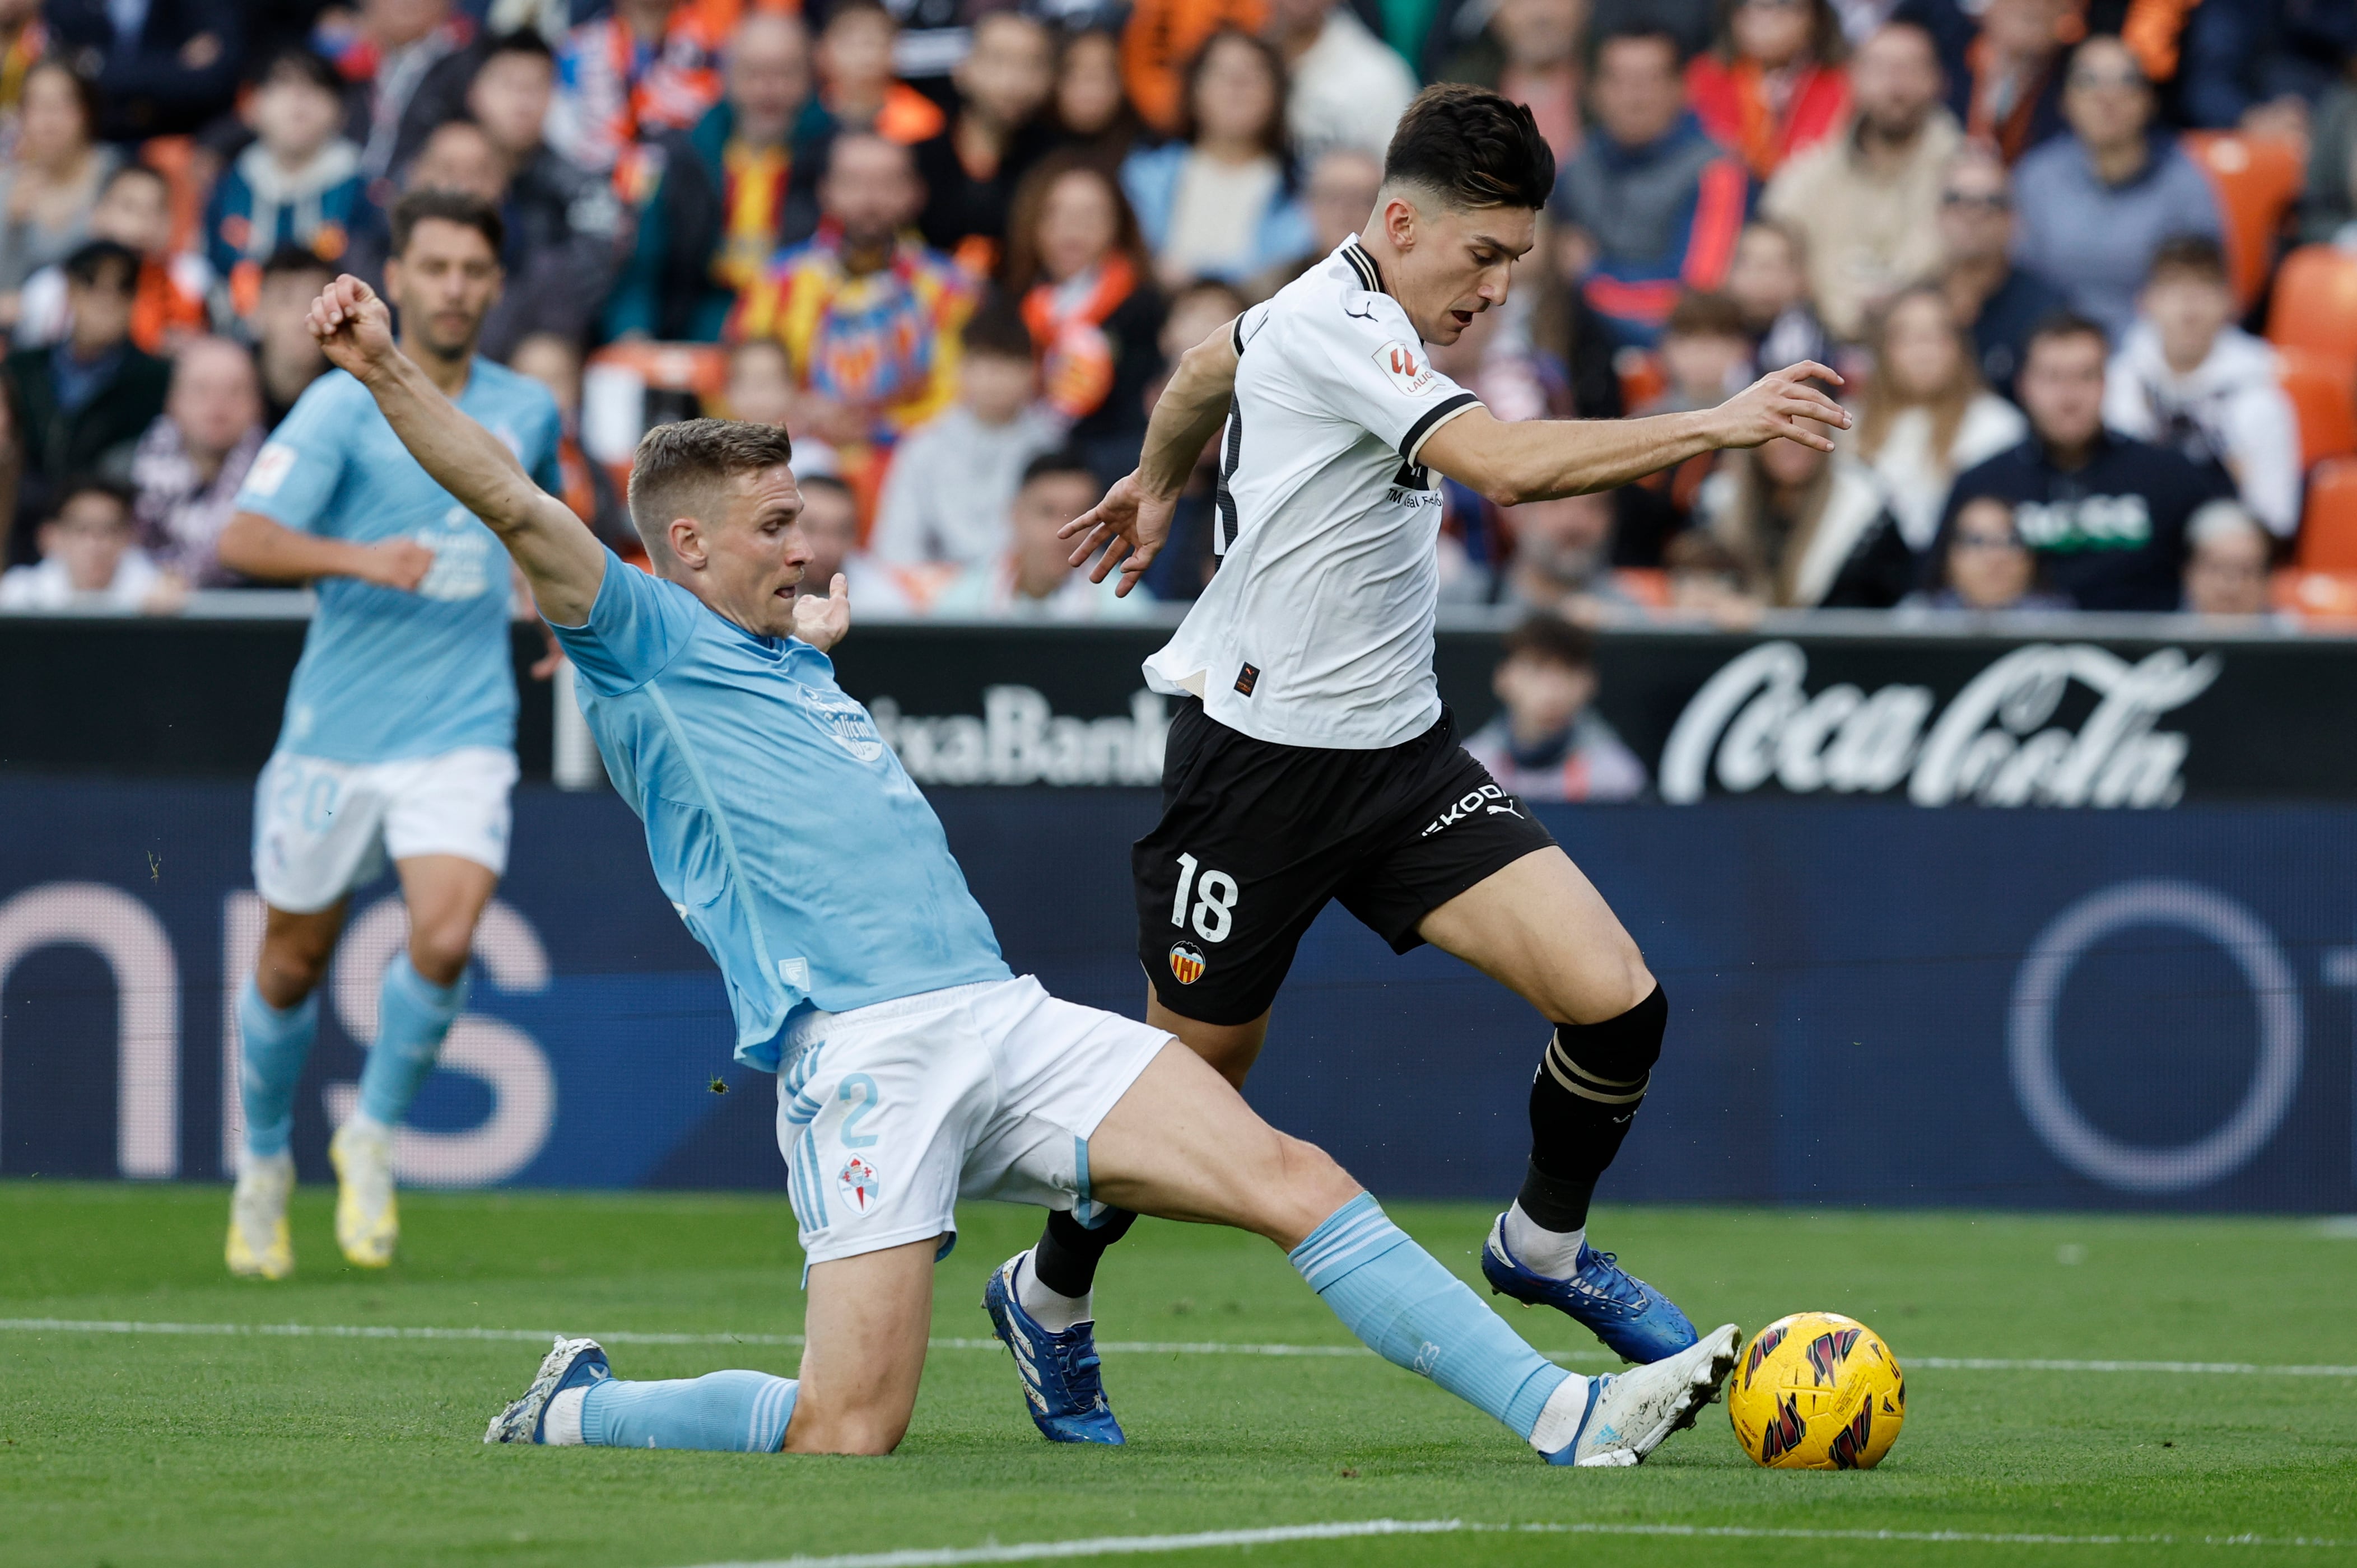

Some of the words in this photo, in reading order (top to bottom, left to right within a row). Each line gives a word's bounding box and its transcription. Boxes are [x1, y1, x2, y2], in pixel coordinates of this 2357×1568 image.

[1407, 371, 1434, 393] LALIG
[1386, 488, 1404, 504] TM
[869, 683, 1176, 786] ixaBank
[1421, 784, 1507, 837] KOD
[1171, 851, 1239, 943] 18
[839, 1072, 879, 1149] 2
